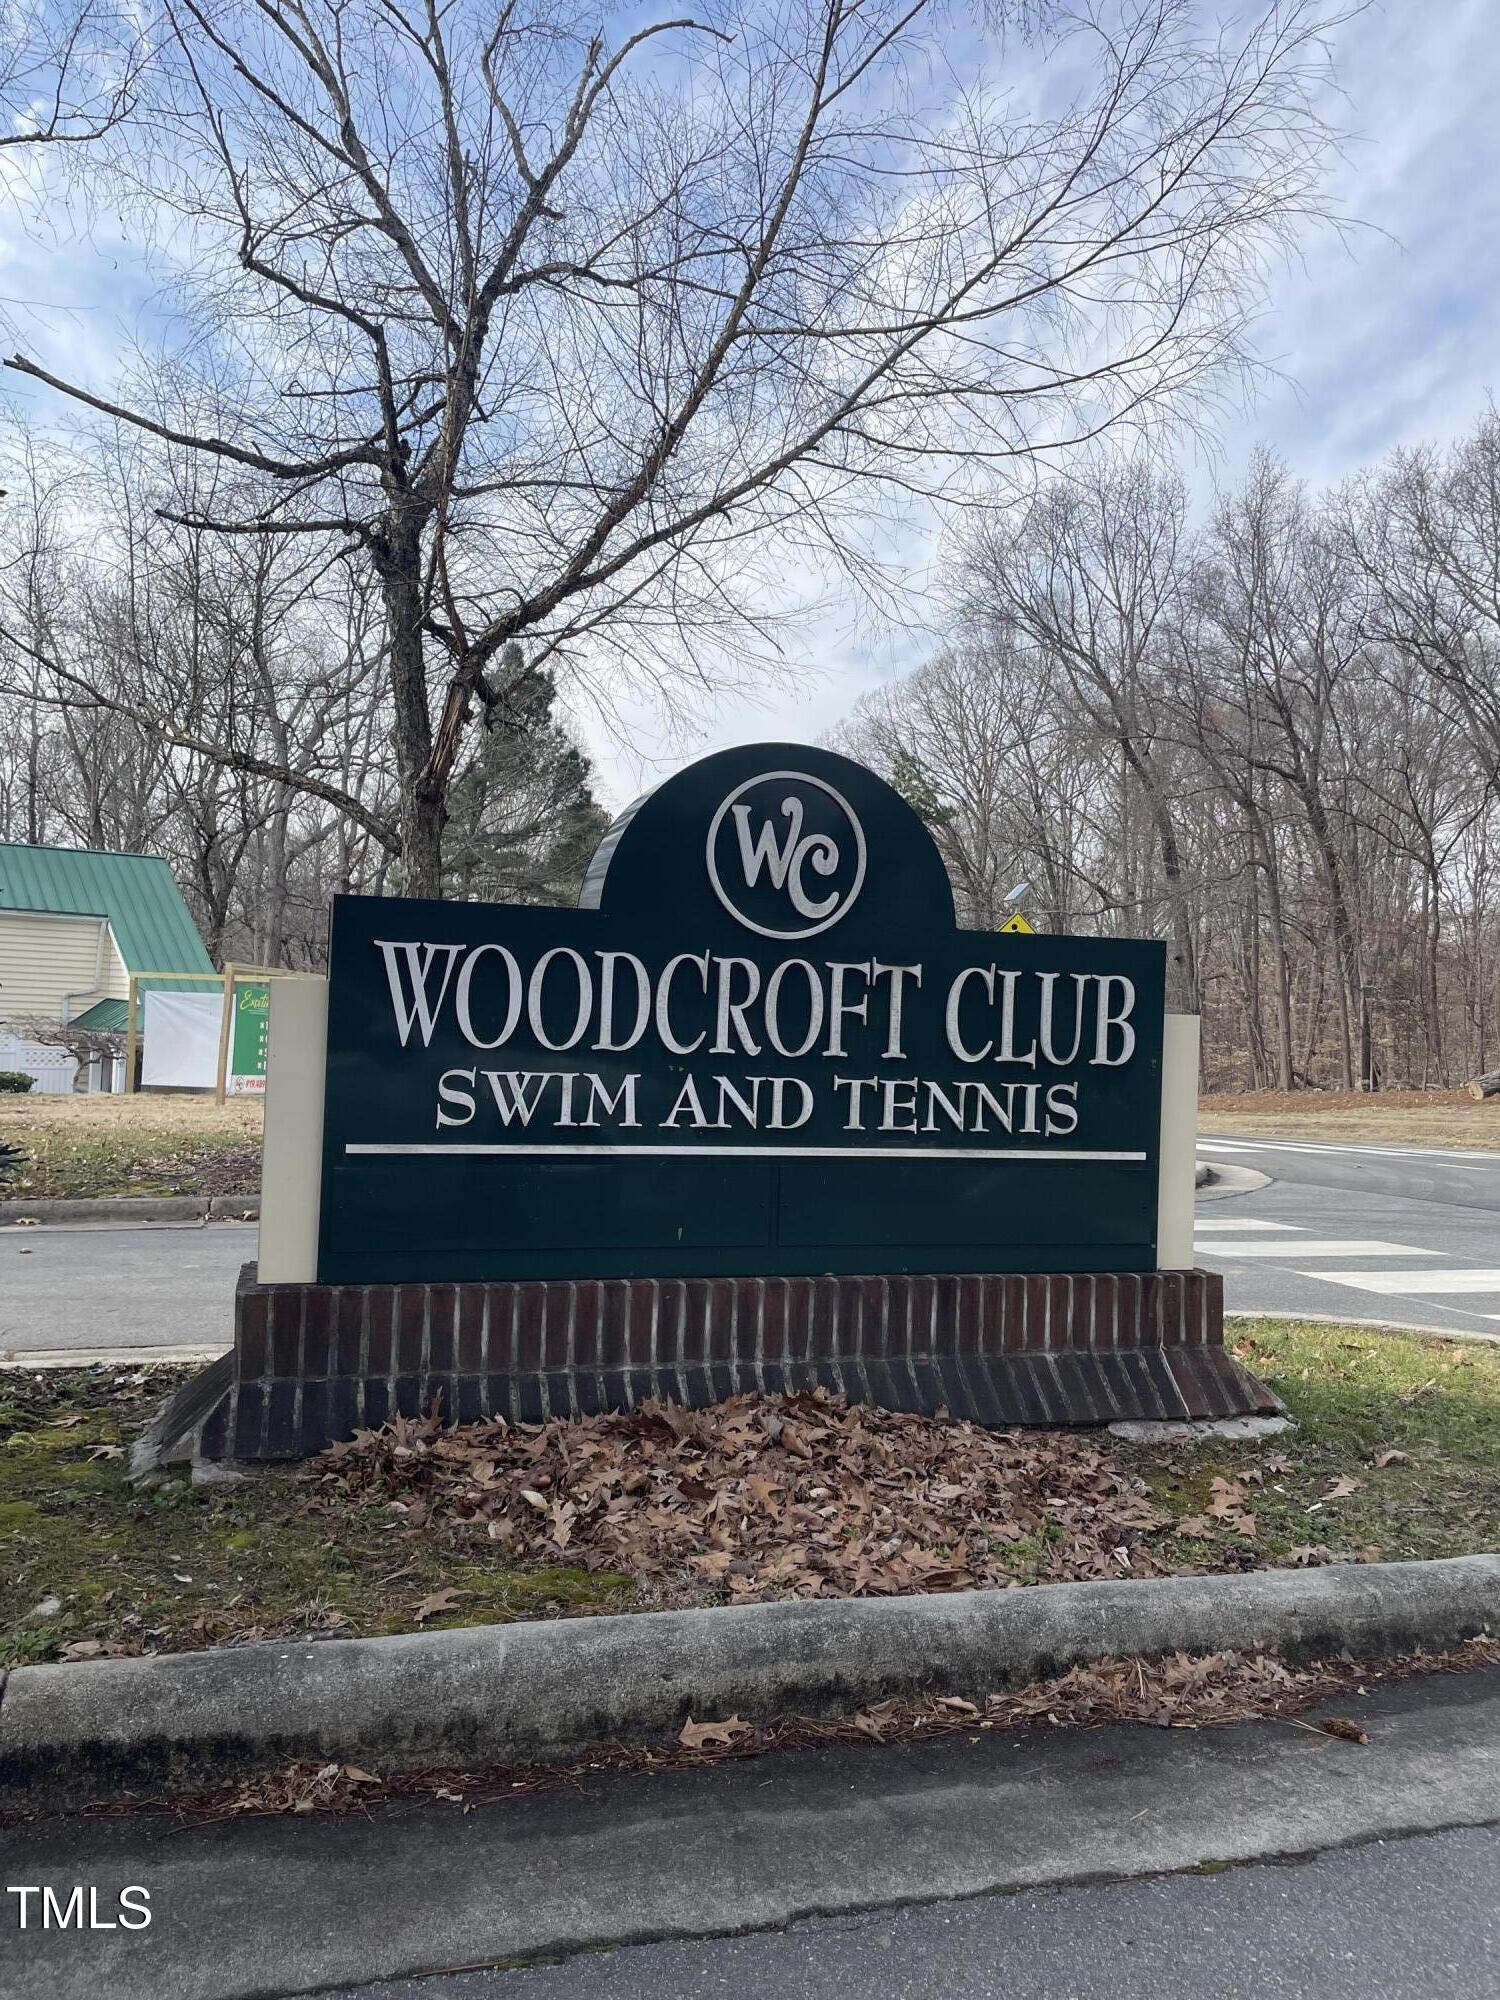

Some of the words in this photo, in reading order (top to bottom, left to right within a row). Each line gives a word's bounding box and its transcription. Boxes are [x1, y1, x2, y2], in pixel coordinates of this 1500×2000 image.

[731, 796, 839, 919] WC
[373, 939, 922, 1059] WOODCROFT
[945, 962, 1136, 1070] CLUB
[436, 1066, 642, 1130] SWIM
[658, 1073, 814, 1130] AND
[833, 1074, 1078, 1137] TENNIS
